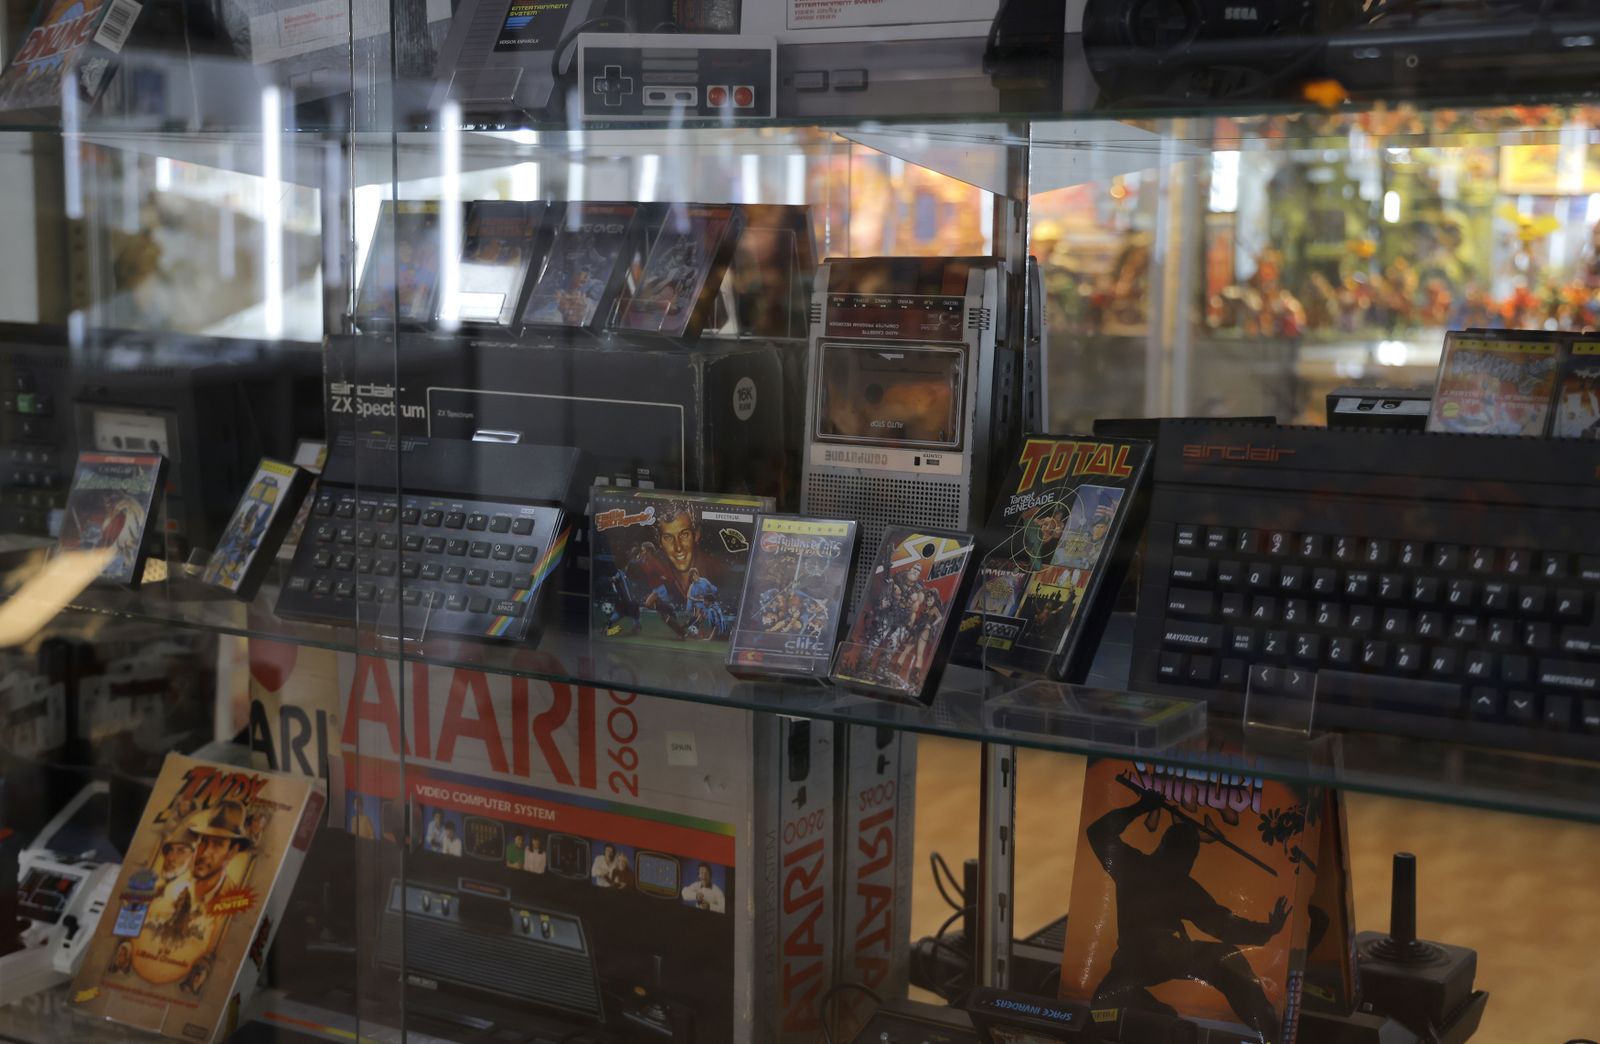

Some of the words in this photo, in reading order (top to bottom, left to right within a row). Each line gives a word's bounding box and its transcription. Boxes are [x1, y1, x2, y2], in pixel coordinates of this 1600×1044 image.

[1224, 7, 1258, 20] SEGA
[331, 396, 353, 413] ZX
[737, 387, 753, 402] 16K
[870, 420, 886, 428] STOP
[887, 421, 904, 429] AUTO
[337, 435, 429, 452] snclair
[1183, 443, 1297, 462] sinclair
[1016, 439, 1133, 494] TOTAL
[1004, 493, 1054, 517] RENEGADE
[1010, 492, 1036, 506] Target
[1272, 543, 1280, 552] 2
[1304, 544, 1312, 555] 3
[1438, 554, 1448, 566] 7
[1282, 576, 1294, 586] W
[1314, 578, 1324, 589] E
[1347, 582, 1357, 592] R
[1381, 584, 1390, 595] T
[1415, 587, 1424, 598] Y
[1450, 590, 1461, 602] U
[1559, 600, 1570, 612] P
[1254, 606, 1264, 617] A
[1286, 610, 1295, 620] S
[1318, 613, 1328, 623] D
[1352, 616, 1360, 626] F
[1385, 619, 1395, 630] G
[1420, 623, 1431, 634] H
[1454, 626, 1465, 637] J
[1490, 630, 1502, 641] K
[1165, 632, 1208, 644] MAYUSCULAS
[1265, 641, 1275, 651] Z
[1298, 644, 1309, 655] X
[1331, 647, 1341, 658] C
[1364, 651, 1374, 662] V
[1433, 658, 1445, 670] N
[1469, 662, 1483, 674] M
[341, 632, 597, 790] ATARI
[607, 660, 639, 797] 2600
[250, 699, 327, 778] ARI
[671, 744, 692, 752] SPAIN
[182, 766, 268, 808] INDY
[415, 784, 449, 800] VIDEO
[452, 792, 511, 812] COMPUTER
[514, 803, 556, 821] SYSTEM
[784, 808, 825, 845] 2600
[783, 837, 825, 1033] ATARI
[995, 999, 1040, 1014] INVADERS
[1042, 1008, 1072, 1021] SPACE
